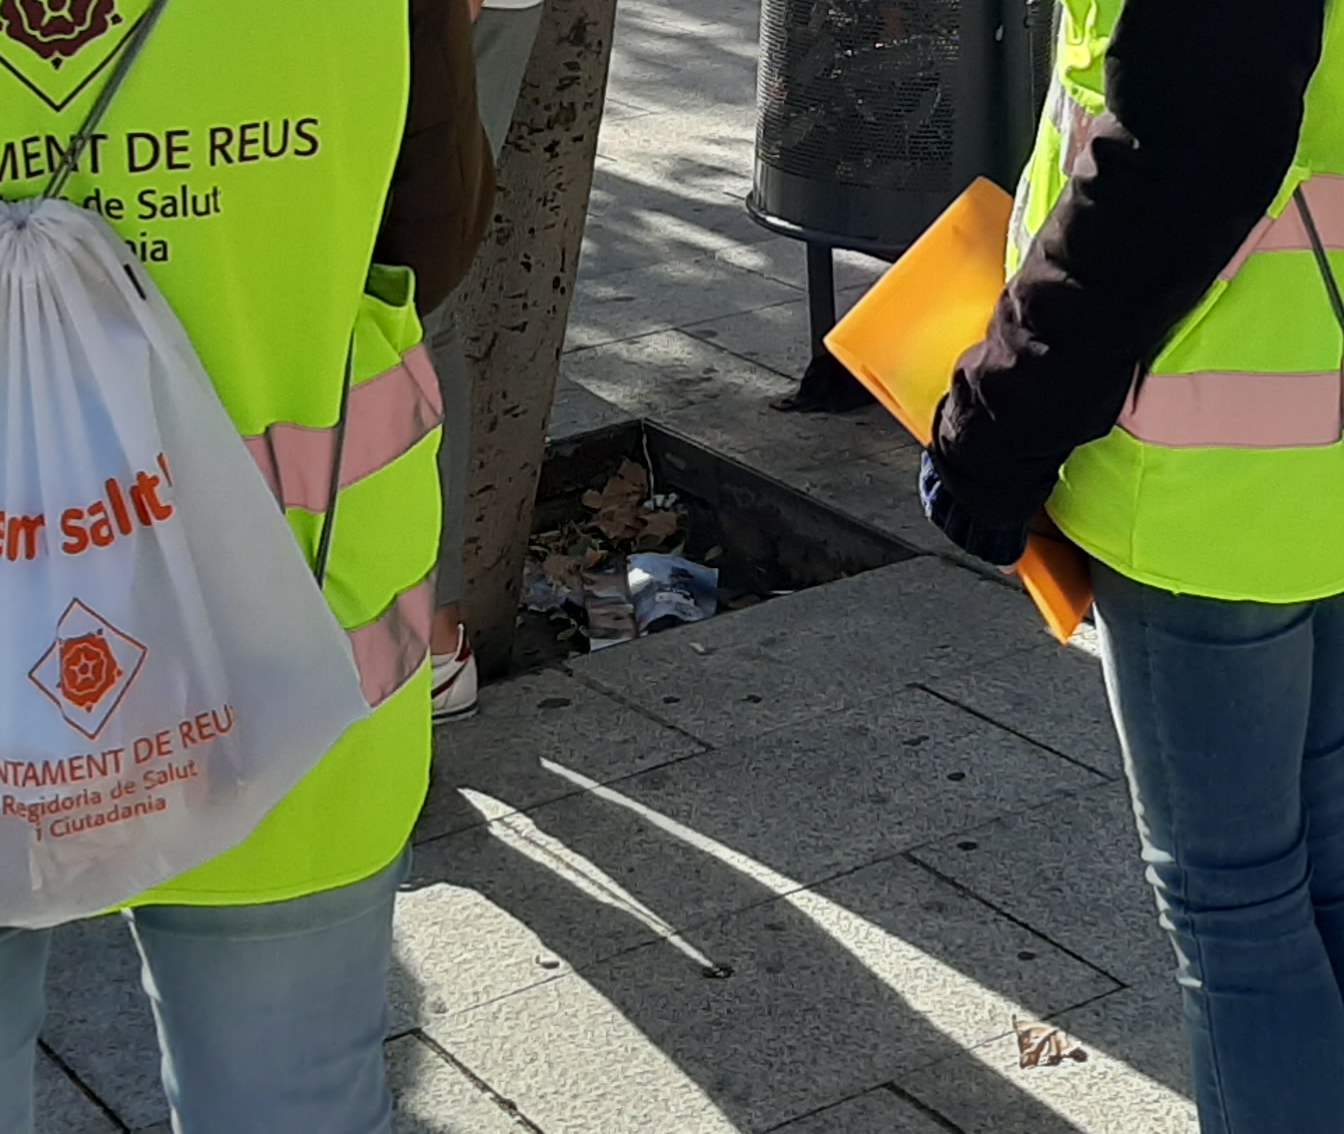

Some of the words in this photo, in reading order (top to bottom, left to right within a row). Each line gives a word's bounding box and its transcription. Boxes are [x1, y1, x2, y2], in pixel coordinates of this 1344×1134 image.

[125, 129, 192, 173] DE
[208, 118, 320, 167] REUS
[83, 187, 125, 220] de
[137, 184, 222, 221] Salut
[133, 729, 175, 765] DE
[178, 703, 236, 750] REU
[2, 788, 102, 824] Regidoria
[110, 778, 137, 800] de
[142, 759, 198, 791] Salut
[49, 796, 168, 840] Ciutadania
